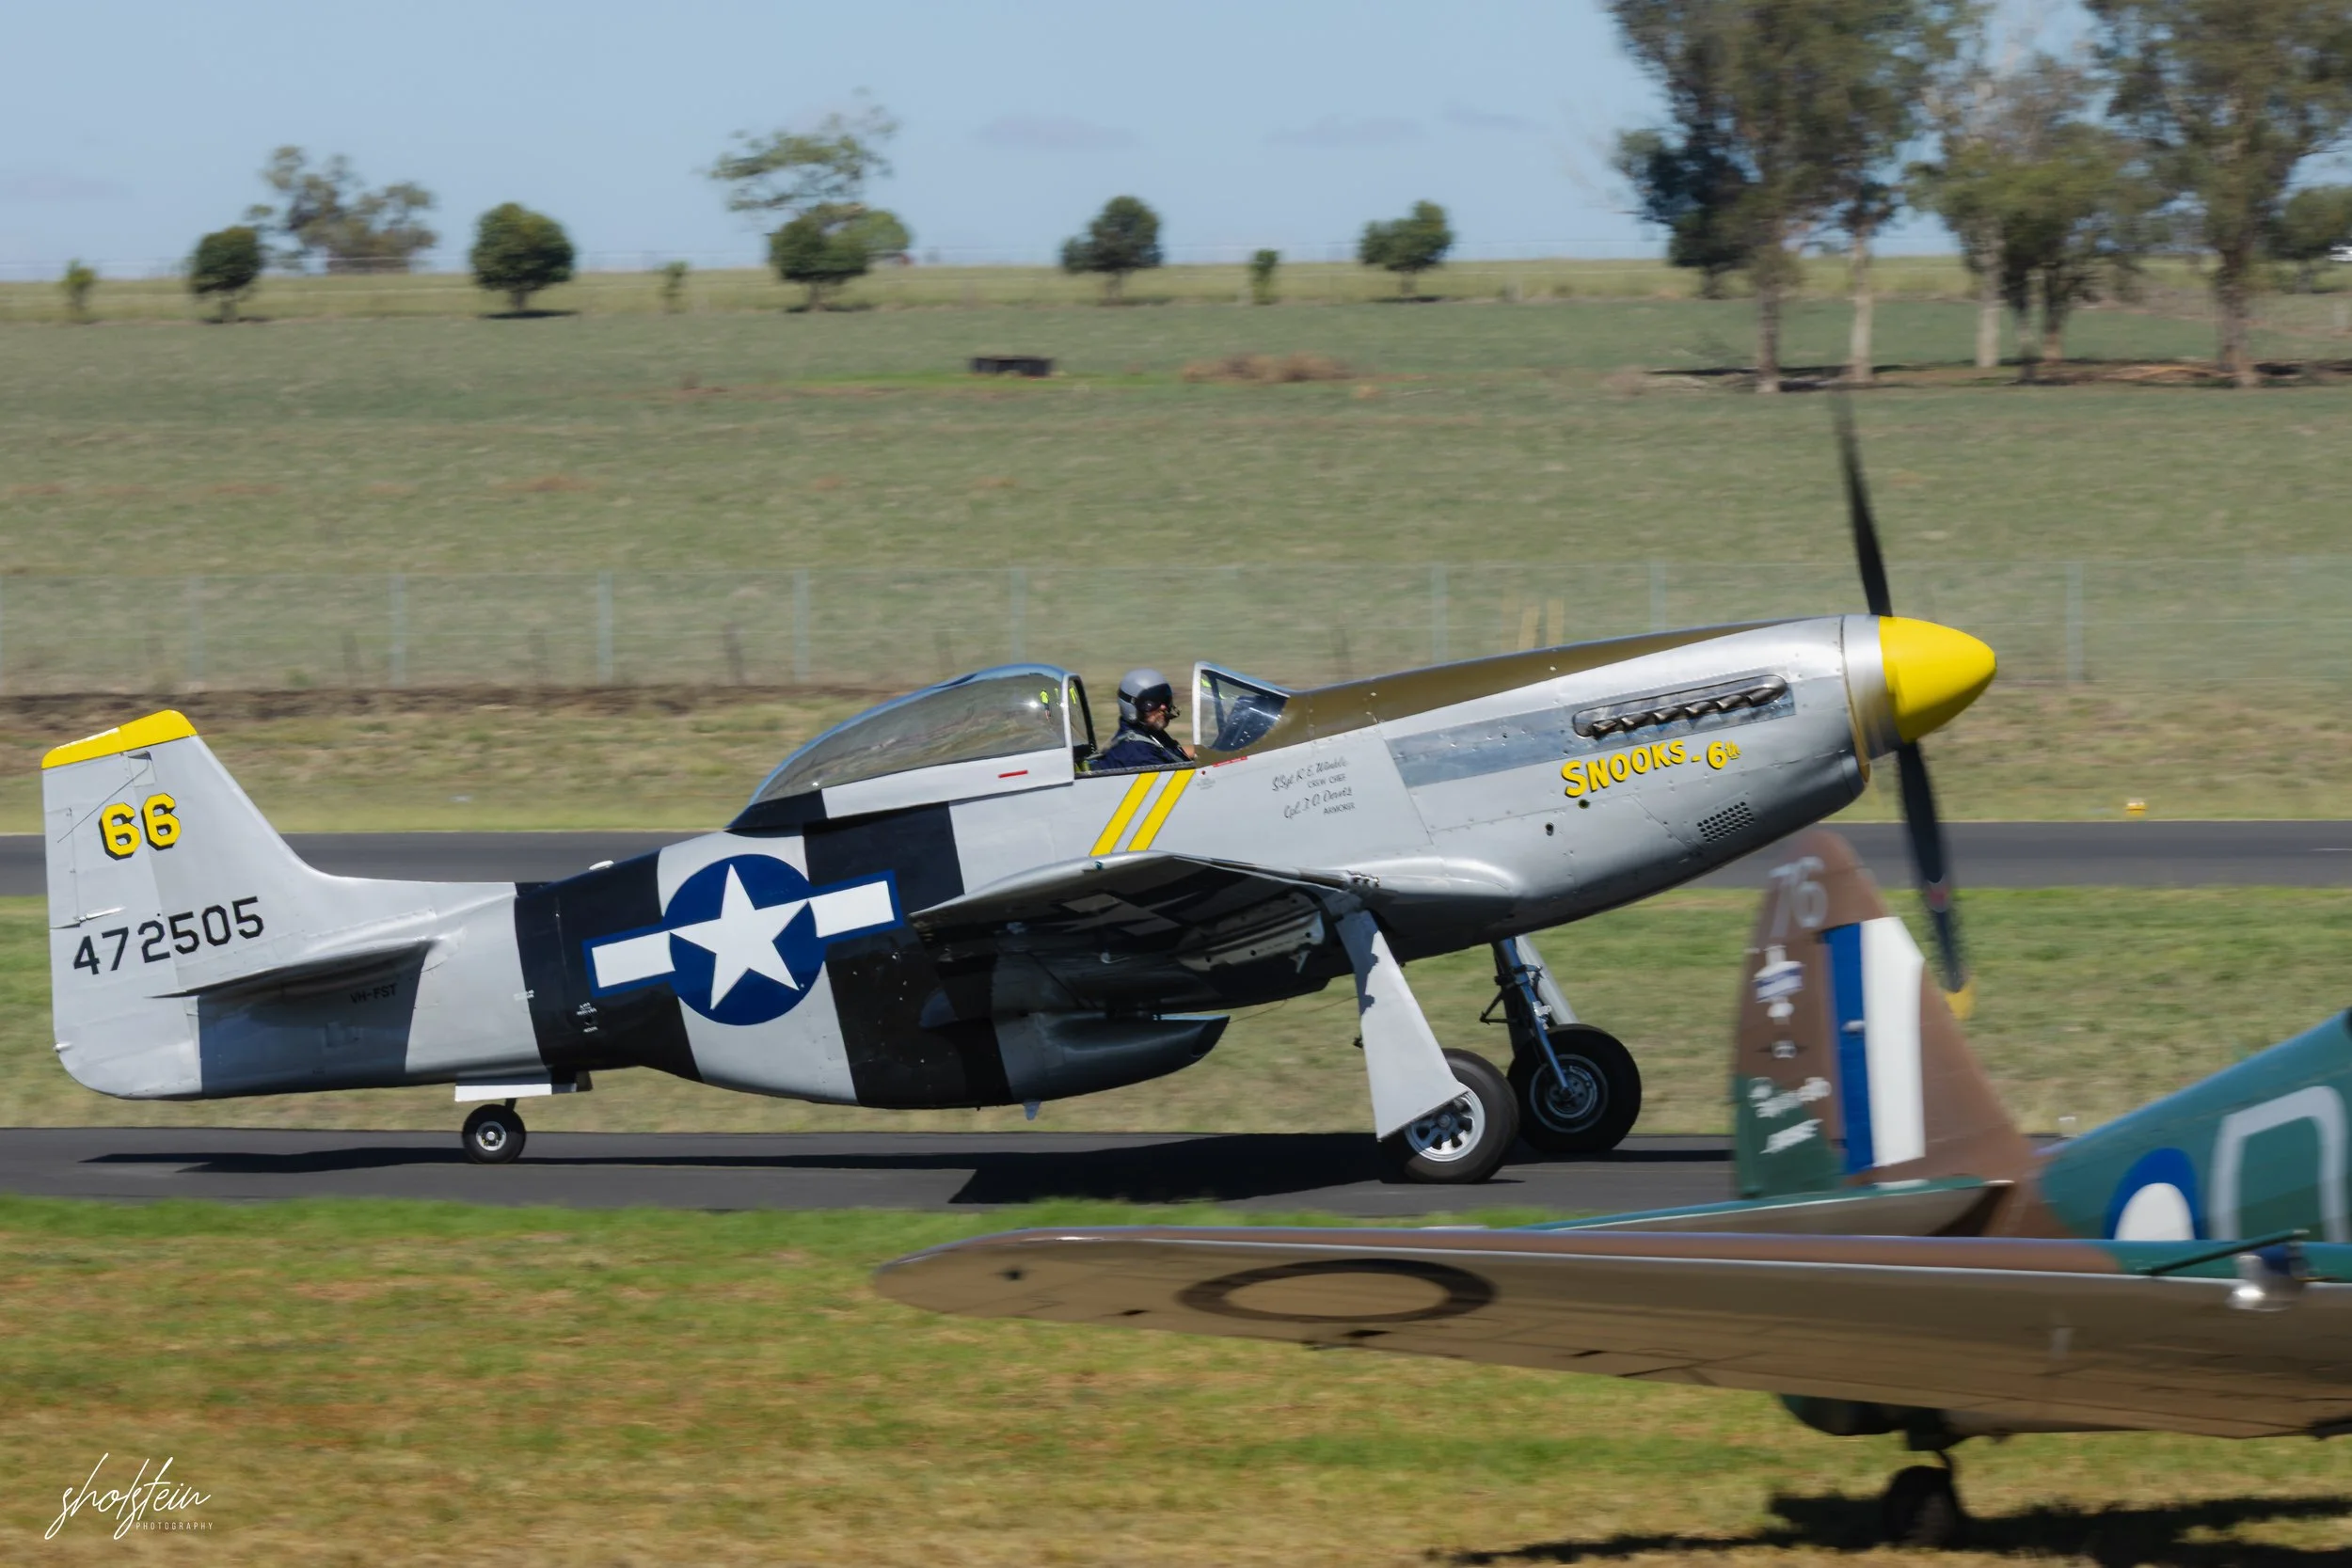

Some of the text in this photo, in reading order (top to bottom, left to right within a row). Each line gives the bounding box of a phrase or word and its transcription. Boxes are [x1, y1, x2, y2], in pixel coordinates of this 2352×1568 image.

[1561, 739, 1687, 798] SNOOKS
[1707, 740, 1741, 769] 6th
[98, 793, 182, 861] 66
[72, 895, 264, 975] 472505
[349, 982, 398, 1004] VH-FST
